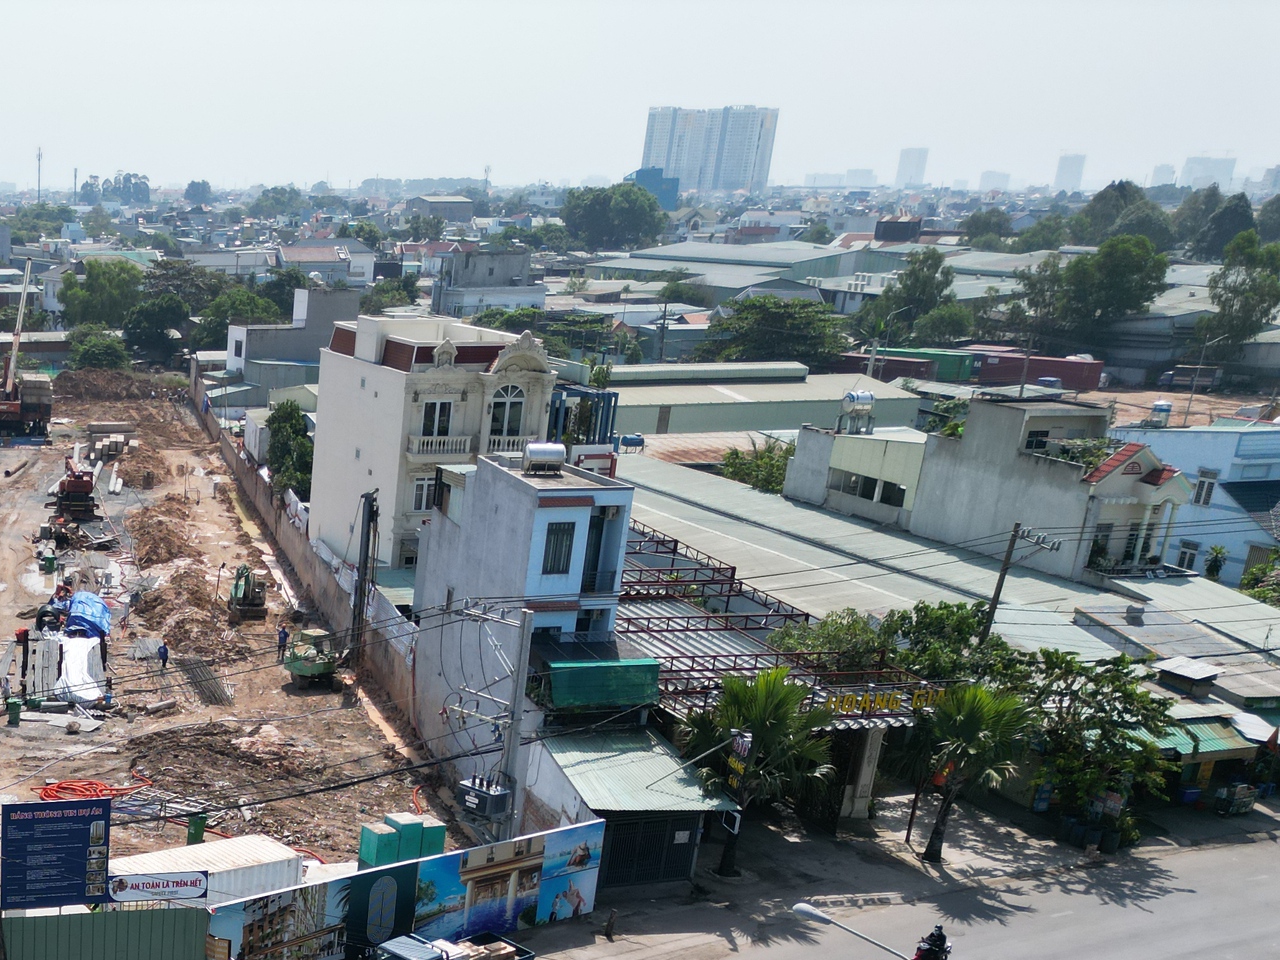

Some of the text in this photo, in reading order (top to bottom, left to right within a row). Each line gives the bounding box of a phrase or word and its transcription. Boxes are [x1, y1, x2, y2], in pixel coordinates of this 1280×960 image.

[129, 876, 203, 890] AN TOÀN LÀ TRÊN HẾT
